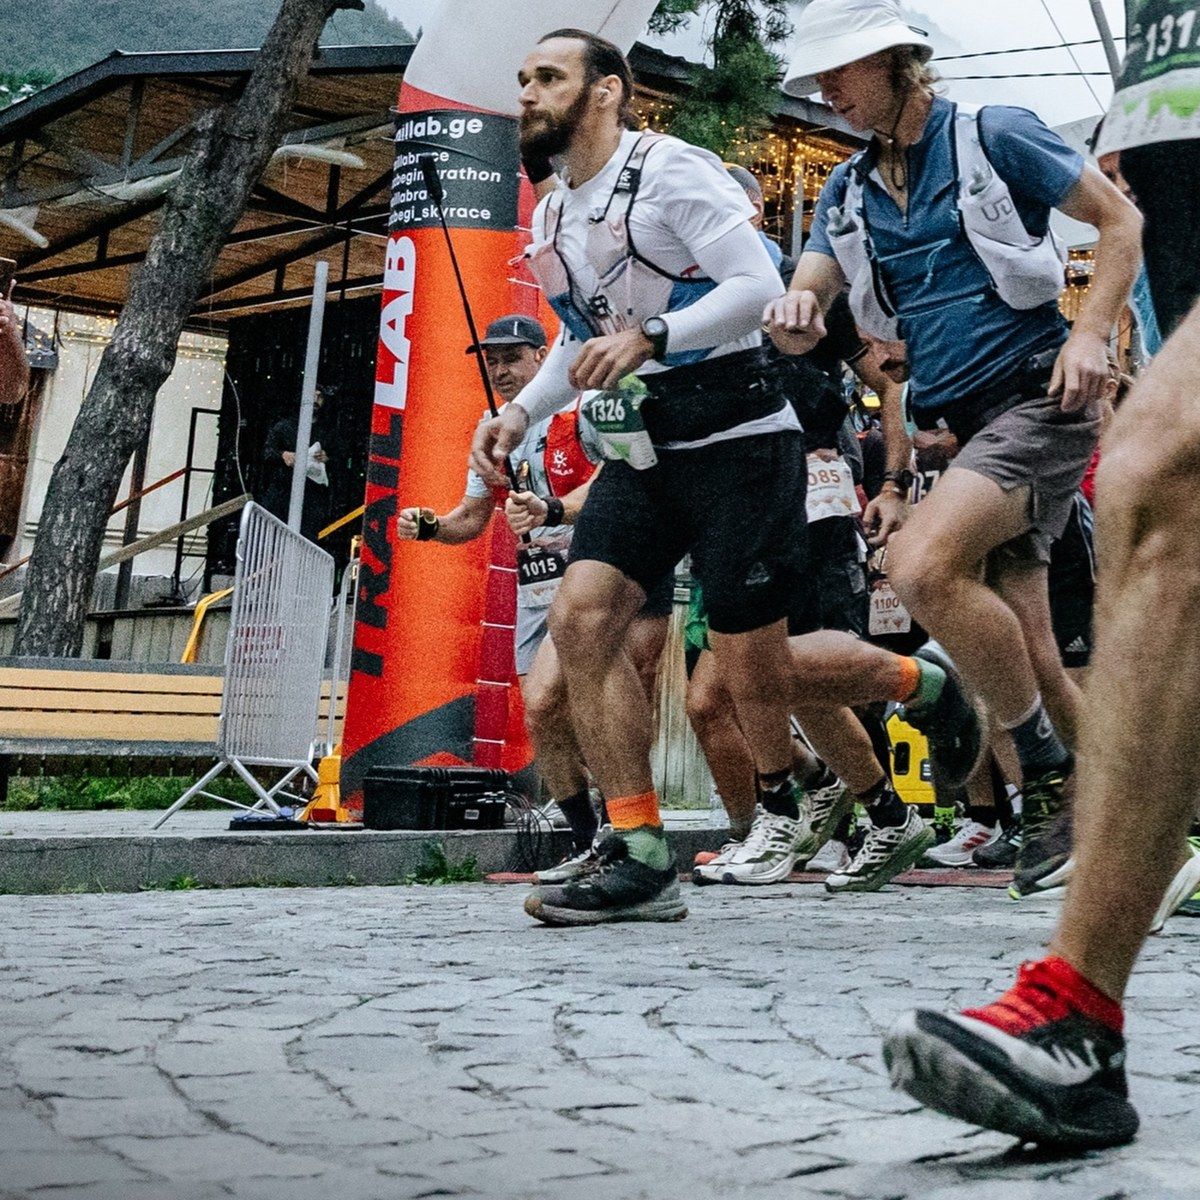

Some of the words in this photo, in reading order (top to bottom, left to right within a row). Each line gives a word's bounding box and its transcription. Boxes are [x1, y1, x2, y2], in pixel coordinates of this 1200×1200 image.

[590, 398, 626, 422] 1326
[807, 469, 840, 486] 085
[522, 556, 558, 577] 1015
